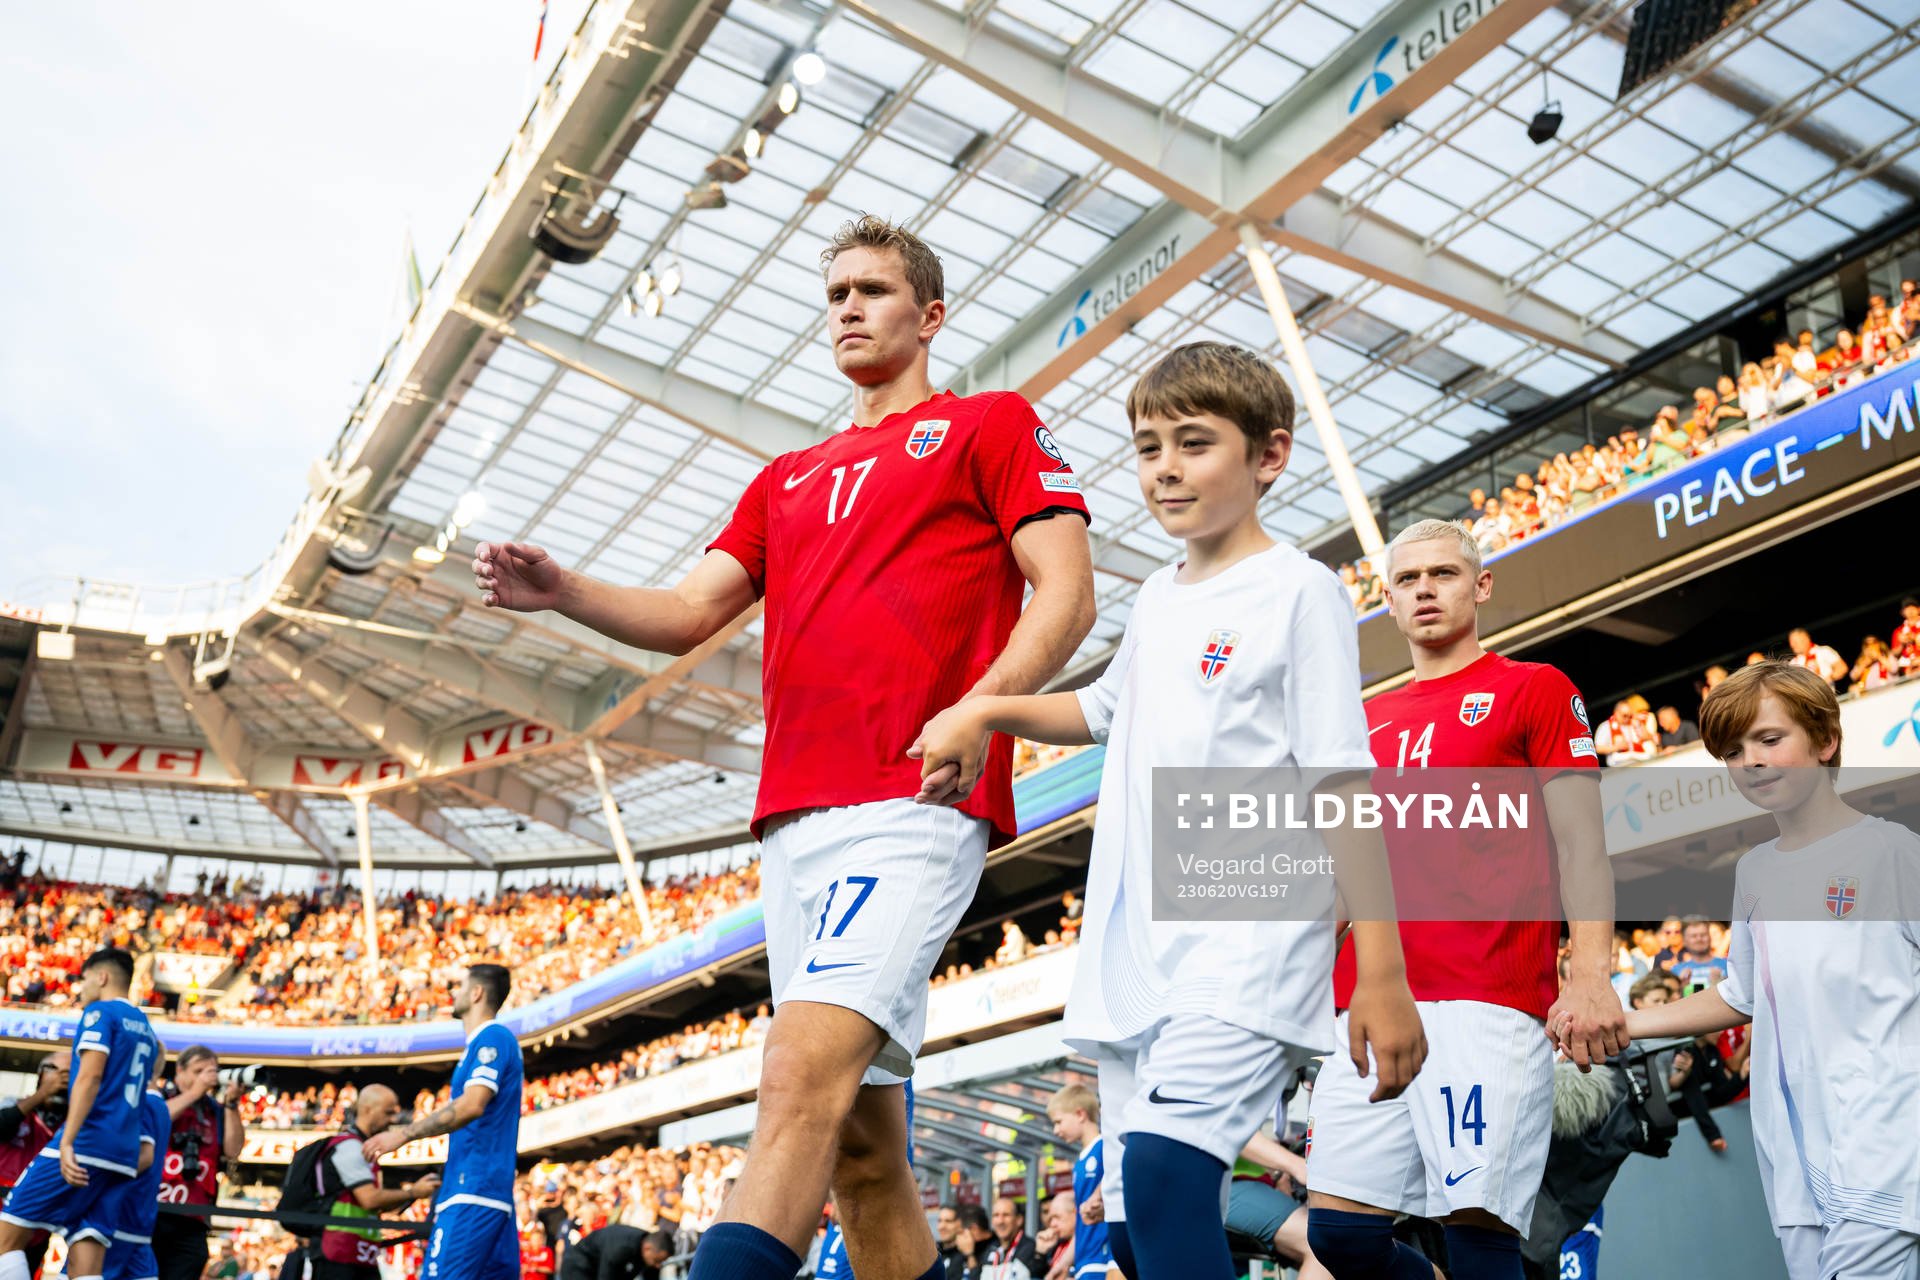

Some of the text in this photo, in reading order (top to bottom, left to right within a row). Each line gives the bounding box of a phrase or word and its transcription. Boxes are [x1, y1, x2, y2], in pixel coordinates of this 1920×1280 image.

[1094, 235, 1180, 322] telenor
[827, 456, 878, 525] 17
[1654, 435, 1805, 538] PEACE
[75, 743, 197, 775] VG
[298, 756, 402, 787] VG
[466, 721, 552, 762] VG
[1397, 722, 1435, 777] 14
[816, 876, 879, 940] 17
[124, 1042, 151, 1109] 5
[1440, 1084, 1487, 1148] 14
[156, 1183, 189, 1205] 20
